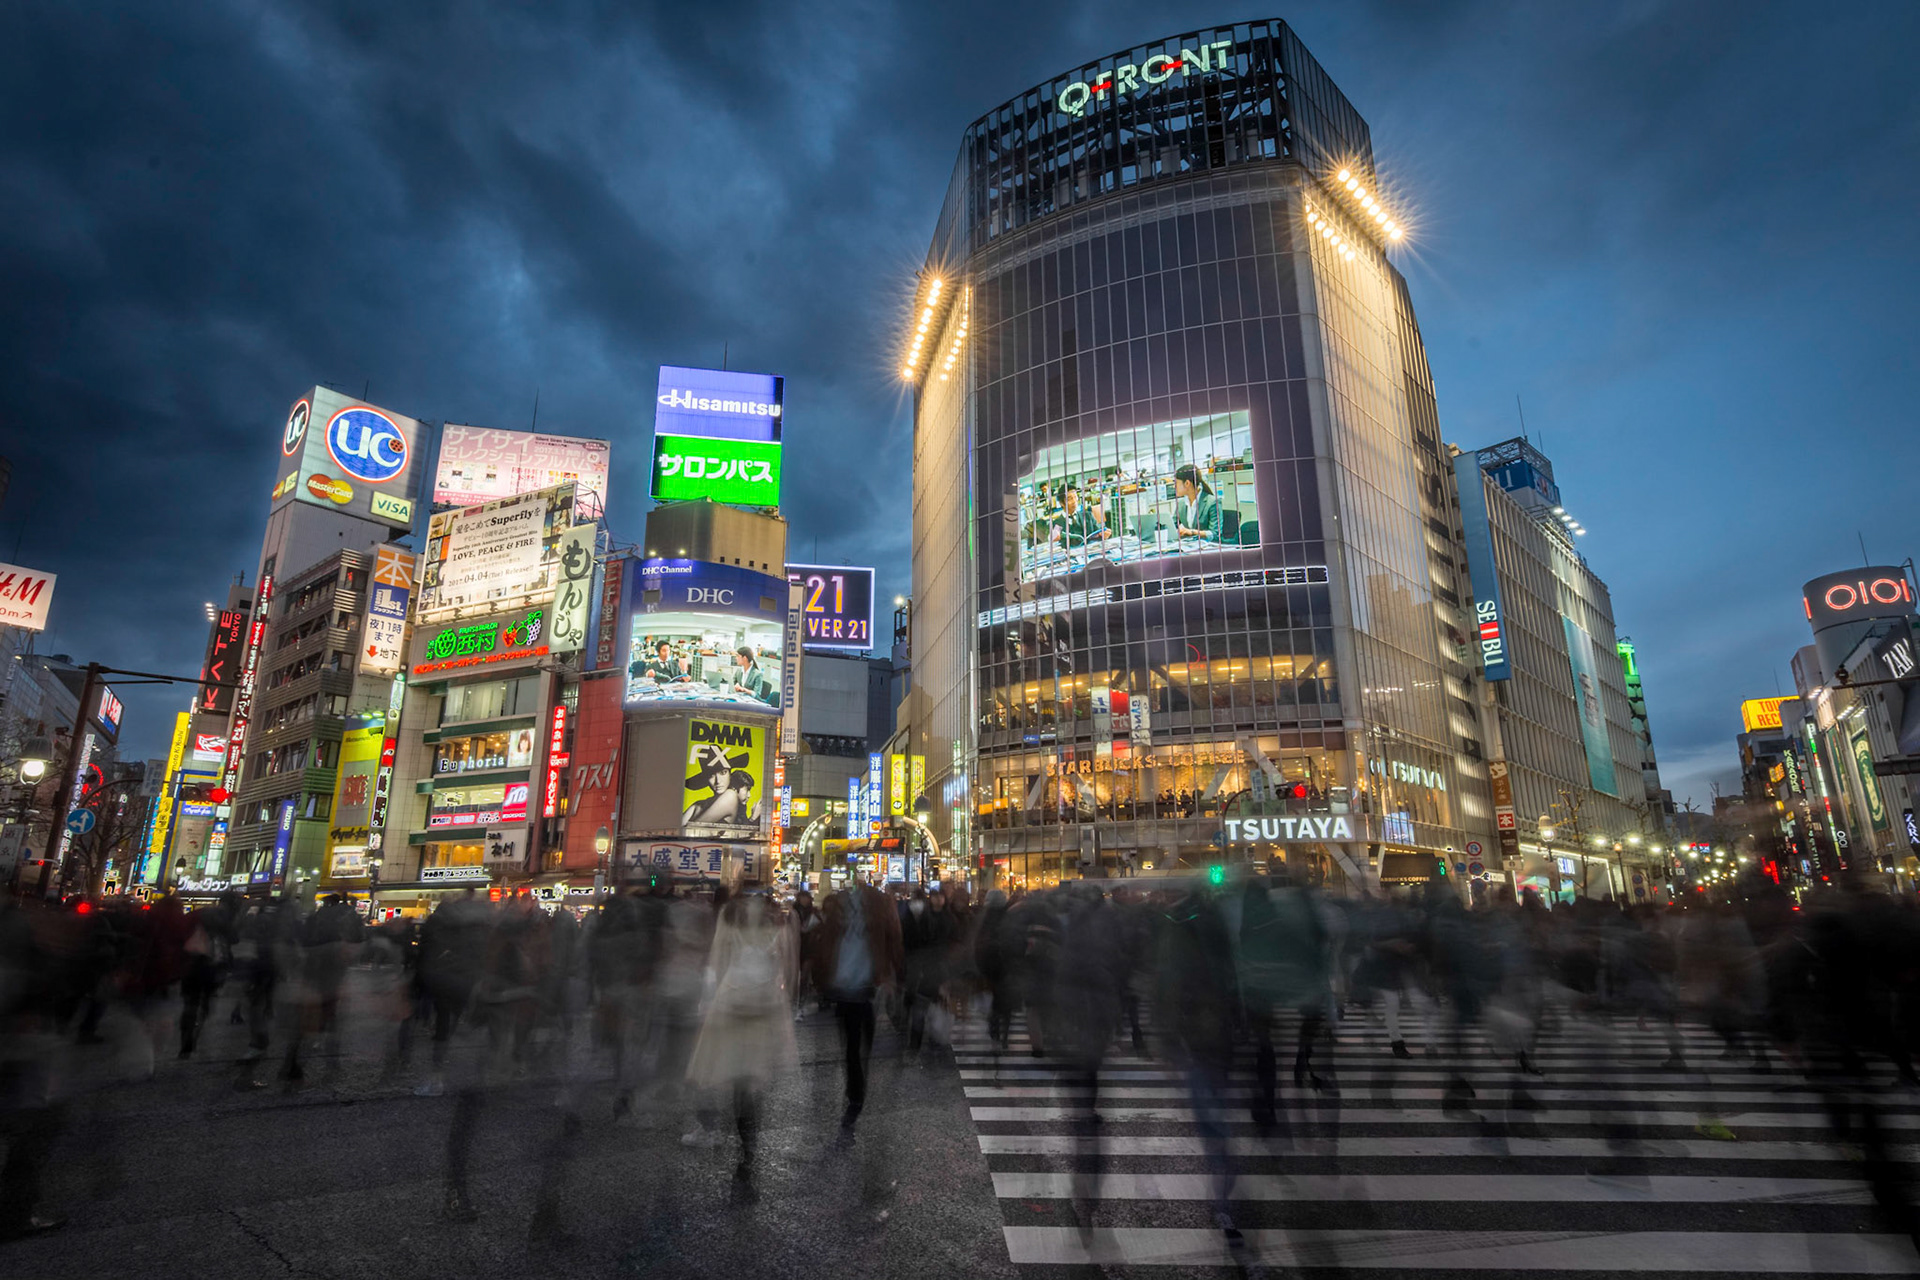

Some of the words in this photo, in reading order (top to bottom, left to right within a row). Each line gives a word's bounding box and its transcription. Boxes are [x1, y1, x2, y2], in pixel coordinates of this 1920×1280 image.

[1059, 41, 1232, 118] QFRONT
[659, 389, 782, 417] Hisamitsu
[337, 418, 404, 468] UC
[445, 427, 536, 453] サイサイ
[442, 445, 593, 472] セレクションアルバム
[659, 454, 773, 484] サロンパス
[377, 500, 409, 517] VISA
[456, 507, 541, 535] 愛をこめてSuperflyを
[453, 548, 476, 562] LOVE,
[478, 543, 505, 557] PEACE
[507, 540, 514, 550] &
[516, 537, 536, 550] FIRE
[377, 552, 414, 588] 本
[642, 566, 659, 575] DHC
[660, 564, 692, 575] Channel
[554, 539, 592, 648] もんじゃ
[687, 587, 734, 607] DHC
[229, 613, 242, 643] TOKYO
[375, 632, 397, 645] まで
[787, 604, 802, 651] Taisei
[849, 619, 868, 640] 21
[1476, 600, 1504, 666] SEIBU
[379, 647, 400, 662] 地下
[456, 631, 496, 656] 西村
[205, 611, 234, 709] KATE
[786, 663, 798, 709] neon
[691, 721, 752, 749] DMM
[441, 757, 504, 773] Euphoria
[689, 744, 732, 769] FX
[1046, 755, 1157, 777] STARBUCKS
[1168, 750, 1245, 769] COFFEE
[571, 751, 618, 817] クスリ
[1783, 749, 1802, 793] KARAOKE
[506, 785, 529, 808] JTB
[870, 756, 882, 817] 洋服の青山
[1225, 817, 1353, 841] TSUTAYA
